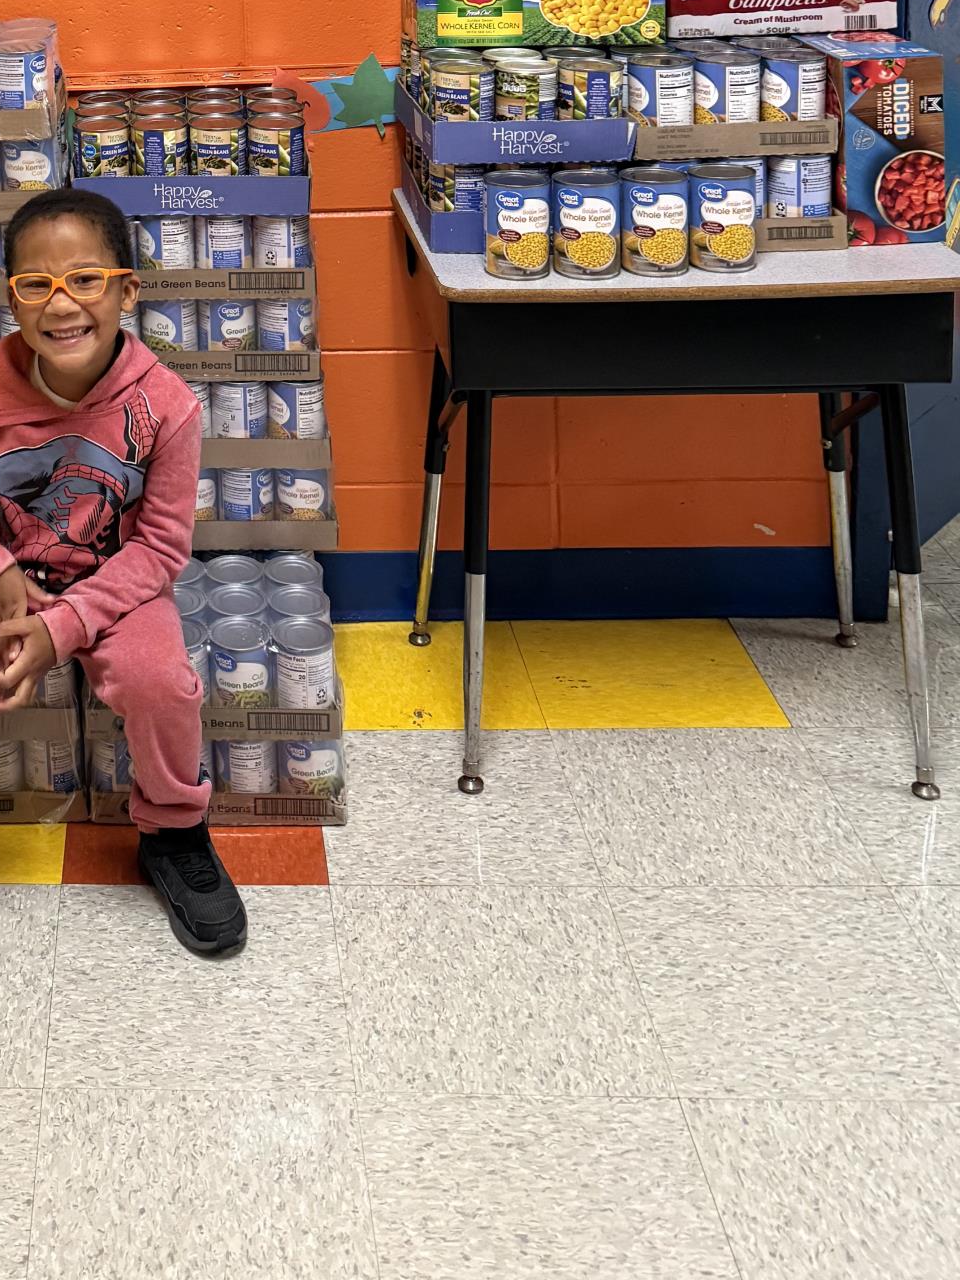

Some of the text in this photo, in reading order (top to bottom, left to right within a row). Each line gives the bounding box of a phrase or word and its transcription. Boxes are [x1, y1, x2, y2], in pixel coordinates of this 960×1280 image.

[733, 13, 823, 25] Cream of Mushroom
[882, 84, 893, 136] TOMATOES
[892, 83, 910, 136] DICED
[492, 127, 545, 144] Happy
[500, 140, 563, 155] Harvest
[153, 183, 201, 199] Happy
[632, 190, 654, 200] Great
[701, 186, 722, 196] Great
[498, 195, 520, 204] Great
[560, 192, 578, 202] Great
[160, 196, 218, 209] Harvest
[704, 204, 753, 215] Whole Kernel
[502, 214, 527, 223] Whole
[562, 212, 612, 222] Whole Kernel
[636, 210, 661, 220] Whole
[160, 280, 226, 289] Green Beans
[167, 360, 232, 370] Green Beans
[210, 720, 245, 728] Beans
